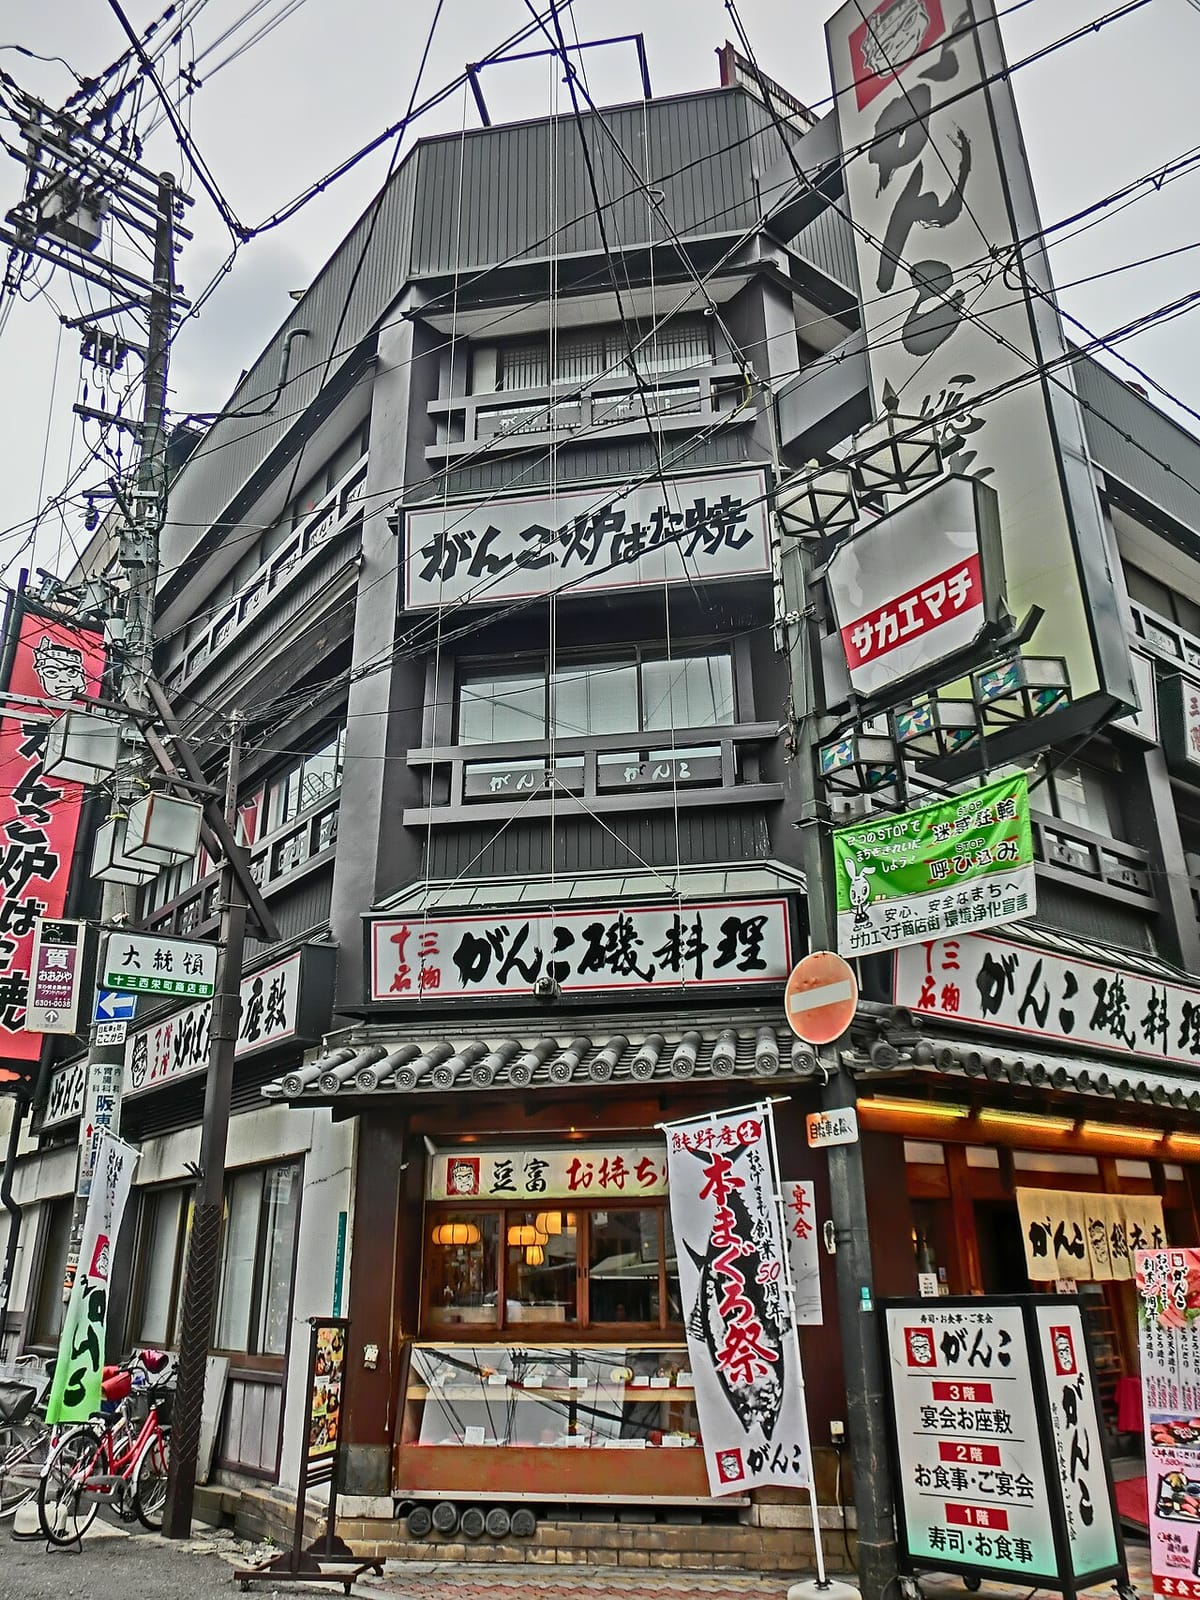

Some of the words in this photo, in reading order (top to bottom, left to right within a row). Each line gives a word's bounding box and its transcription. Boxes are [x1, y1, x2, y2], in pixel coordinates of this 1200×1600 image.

[868, 10, 972, 356] がんこ
[418, 495, 754, 582] がんこ炉ばた焼
[851, 567, 973, 658] サカエマチ
[623, 761, 691, 783] がんこ
[933, 799, 1016, 843] 迷惑駐輪
[957, 800, 983, 816] STOP
[847, 819, 921, 846] 2つのSTOPで
[956, 838, 985, 852] STOP
[930, 841, 1018, 879] 呼び込み
[849, 915, 940, 949] サカエマチ商店街
[944, 892, 1028, 928] 環境浄化宣言
[884, 883, 1019, 922] 安心、安全なまちへ
[45, 948, 69, 969] 質
[121, 944, 204, 976] 大統領
[389, 924, 440, 964] 十三
[453, 909, 769, 987] がんこ磯料理
[38, 970, 73, 982] おおみや
[113, 975, 208, 994] 十三西栄町商店街
[389, 964, 441, 993] 名物
[917, 975, 961, 1012] 名物
[976, 952, 1200, 1057] がんこ磯料理
[97, 1033, 124, 1044] ここから
[489, 1158, 550, 1194] 豆富
[788, 1184, 813, 1241] 宴会
[1029, 1216, 1085, 1260] がんこ
[699, 1153, 778, 1384] 本まぐろ祭
[1173, 1267, 1188, 1309] がんこ
[940, 1327, 1012, 1369] がんこ
[949, 1385, 976, 1401] 3階
[920, 1405, 1013, 1434] 宴会お座敷
[747, 1443, 801, 1476] がんこ
[956, 1445, 983, 1462] 2階
[1062, 1372, 1094, 1527] がんこ
[914, 1464, 1034, 1499] お食事・ご宴会
[964, 1508, 989, 1526] 1階
[928, 1526, 1033, 1563] 寿司・お食事
